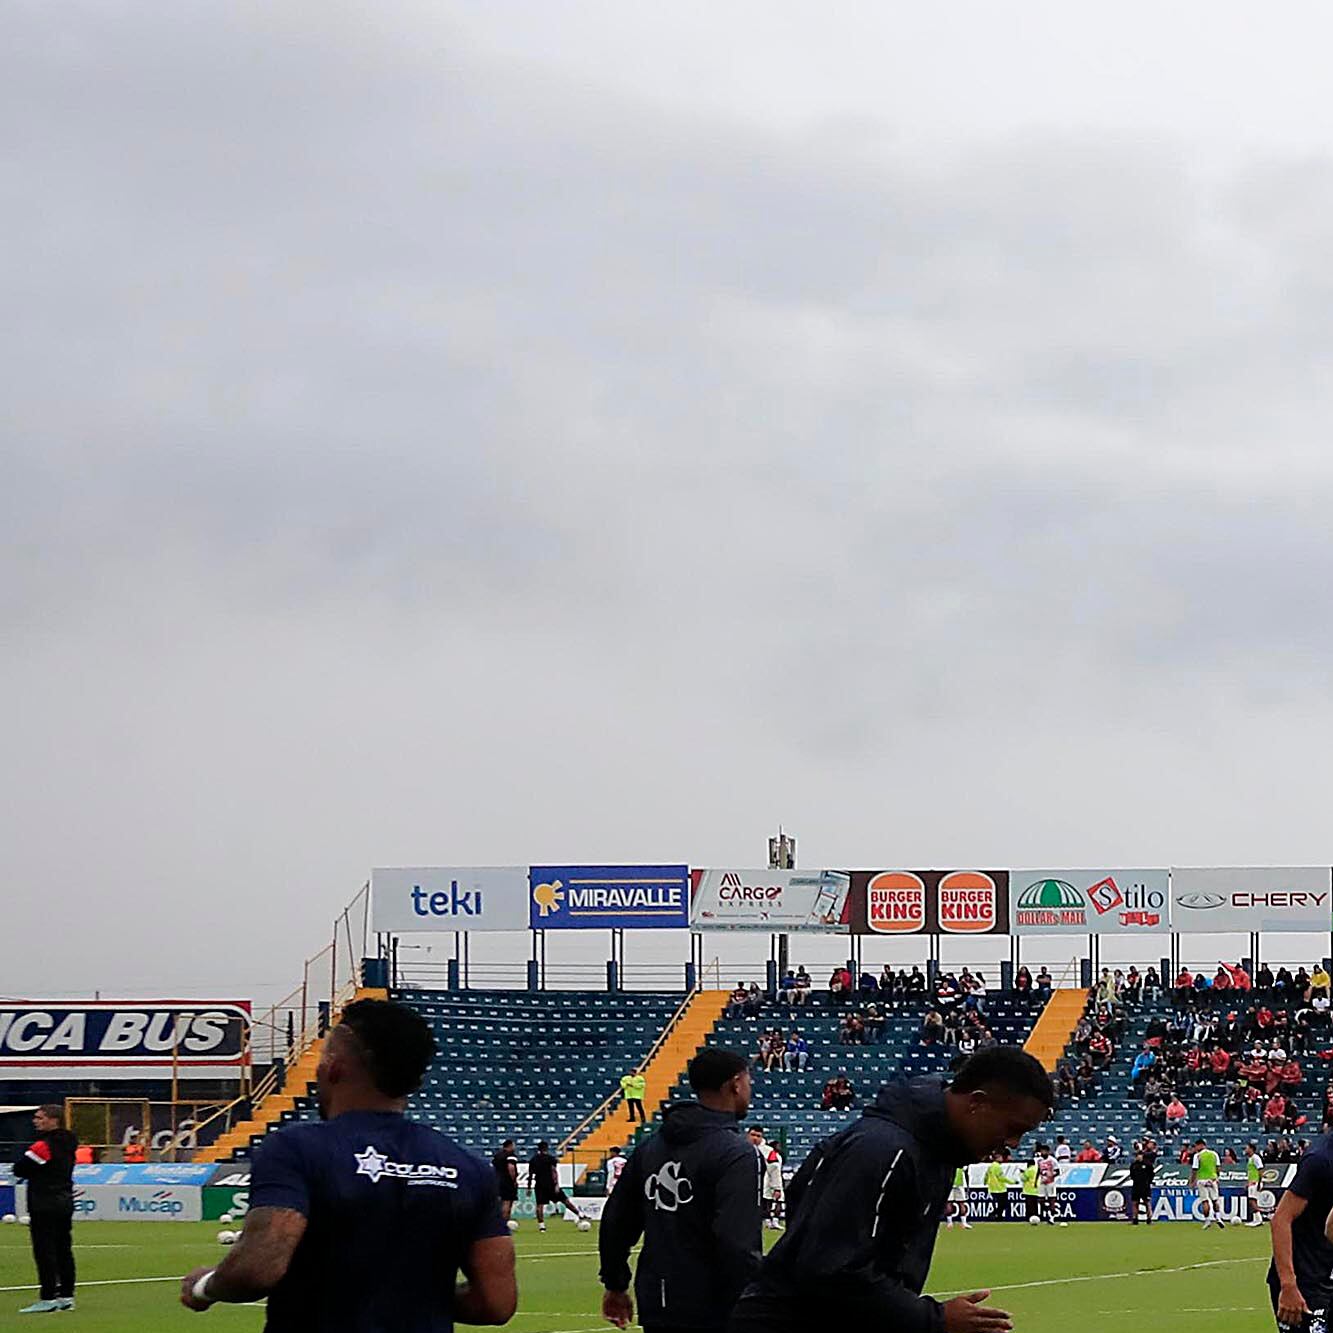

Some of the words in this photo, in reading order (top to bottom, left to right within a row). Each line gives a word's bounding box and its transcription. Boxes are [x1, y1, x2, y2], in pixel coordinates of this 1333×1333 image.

[410, 880, 482, 916] teki
[568, 888, 682, 907] MIRAVALLE
[719, 887, 783, 900] CARGO
[871, 890, 923, 903] BURGER
[941, 890, 993, 903] BURGER
[1231, 892, 1328, 907] CHERY
[871, 903, 923, 919] KING
[941, 903, 993, 919] KING
[99, 1012, 229, 1051] BUS
[383, 1161, 459, 1180] COLONO
[118, 1196, 184, 1219] Mucap
